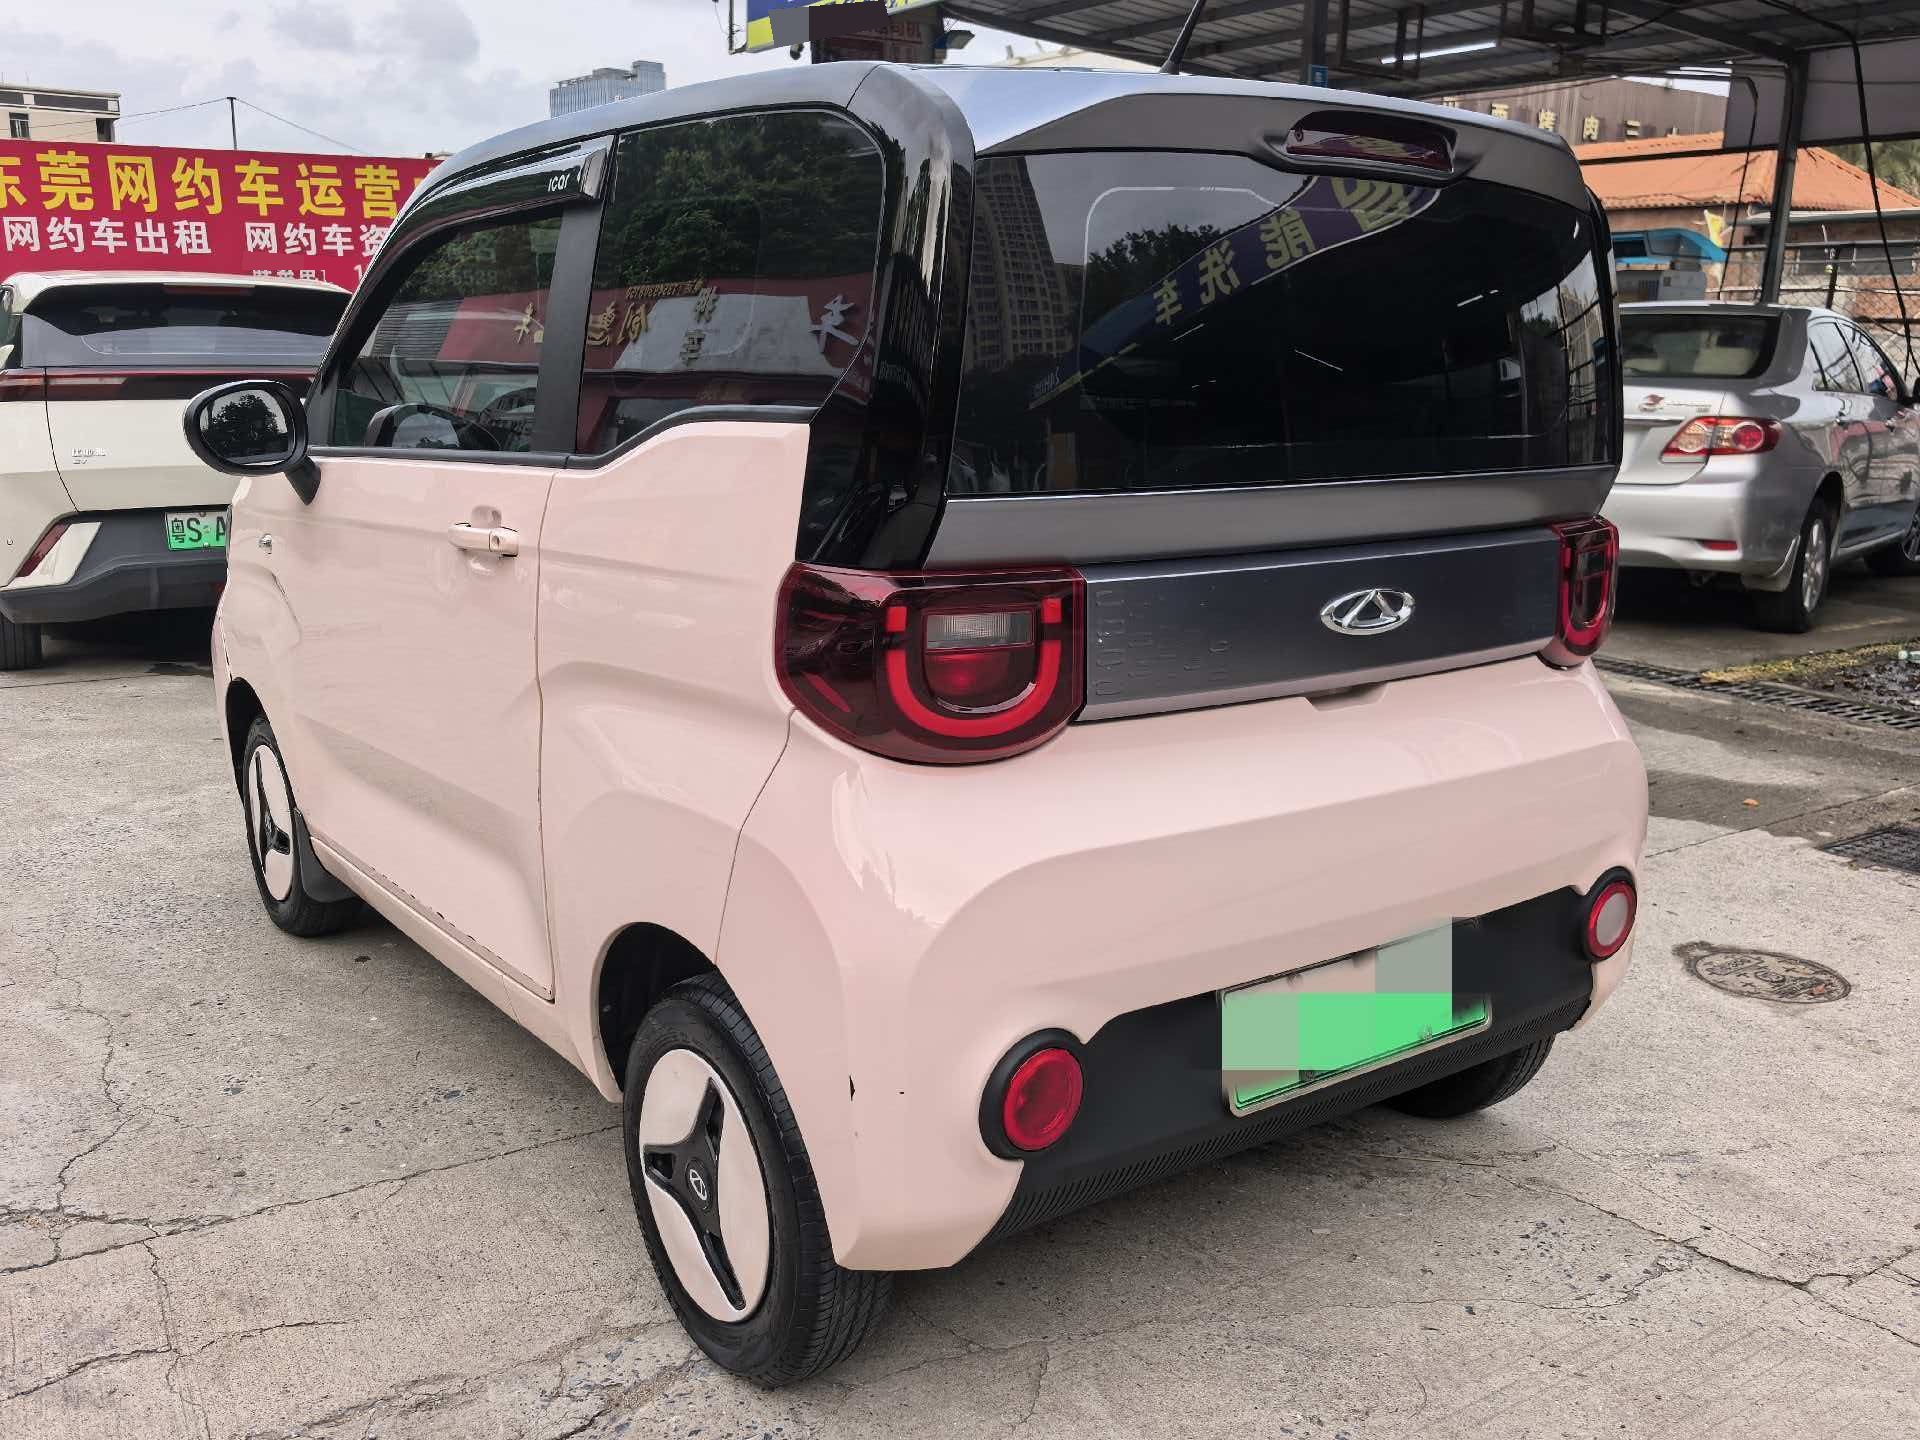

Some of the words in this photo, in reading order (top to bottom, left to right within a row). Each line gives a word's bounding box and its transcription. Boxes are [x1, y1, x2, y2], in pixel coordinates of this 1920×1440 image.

[0, 149, 424, 219] 东莞网约车运营
[3, 216, 212, 256] 网约车出租
